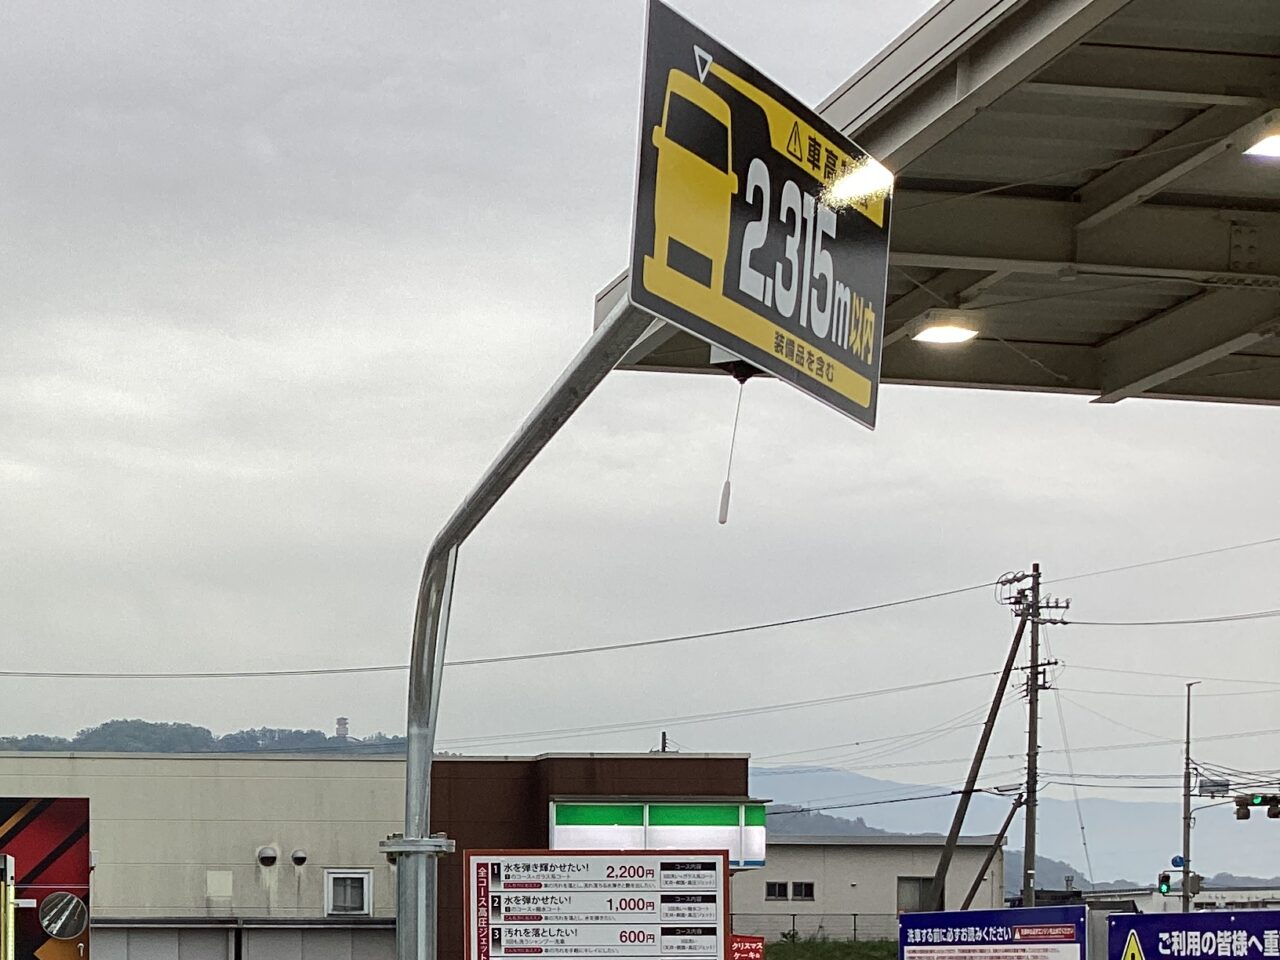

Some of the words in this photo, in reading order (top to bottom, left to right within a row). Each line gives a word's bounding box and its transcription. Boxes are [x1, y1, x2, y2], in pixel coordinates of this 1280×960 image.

[774, 331, 836, 383] 装備品を含む
[606, 865, 655, 879] 2,200円
[504, 896, 571, 905] 水を弾かせたい!
[607, 898, 655, 912] 1,000円
[504, 928, 578, 937] 汚れを落としたい!
[619, 930, 655, 943] 600円
[907, 926, 1012, 943] 洗車する前に必ずお読みください
[1158, 930, 1280, 957] ご利用の皆様へ重
